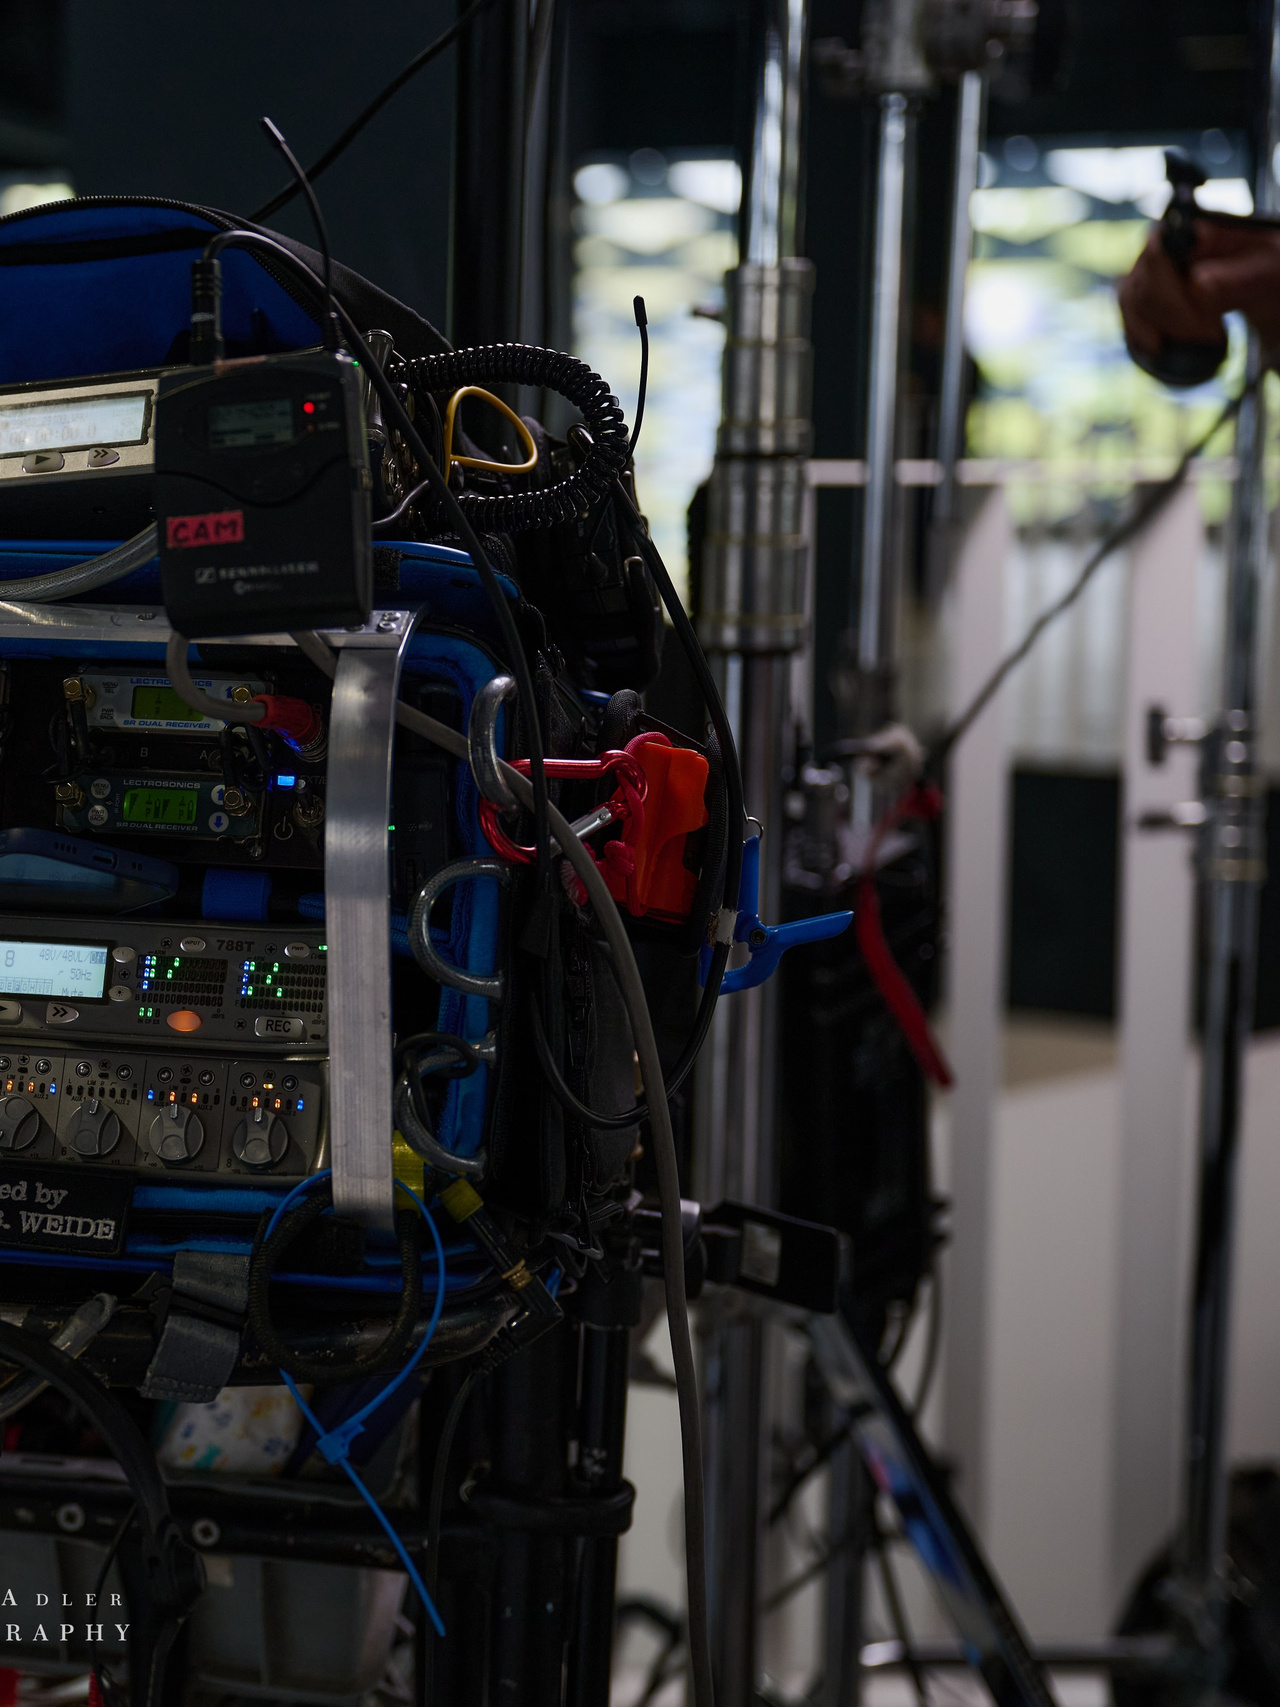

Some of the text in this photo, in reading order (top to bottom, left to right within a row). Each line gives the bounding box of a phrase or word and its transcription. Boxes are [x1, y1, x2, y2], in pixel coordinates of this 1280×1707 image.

[173, 520, 238, 543] CAM
[130, 678, 213, 687] LECTROICS
[140, 747, 149, 757] B
[200, 750, 208, 760] A
[123, 779, 201, 789] LECTROSONICS
[155, 823, 198, 831] RECEIVER
[216, 940, 255, 952] 788T
[4, 949, 15, 967] 8
[265, 1020, 291, 1032] REC
[61, 1147, 67, 1156] 6
[144, 1152, 149, 1161] 7
[226, 1158, 232, 1168] 8
[35, 1182, 68, 1210] by
[19, 1210, 117, 1241] WEIDE
